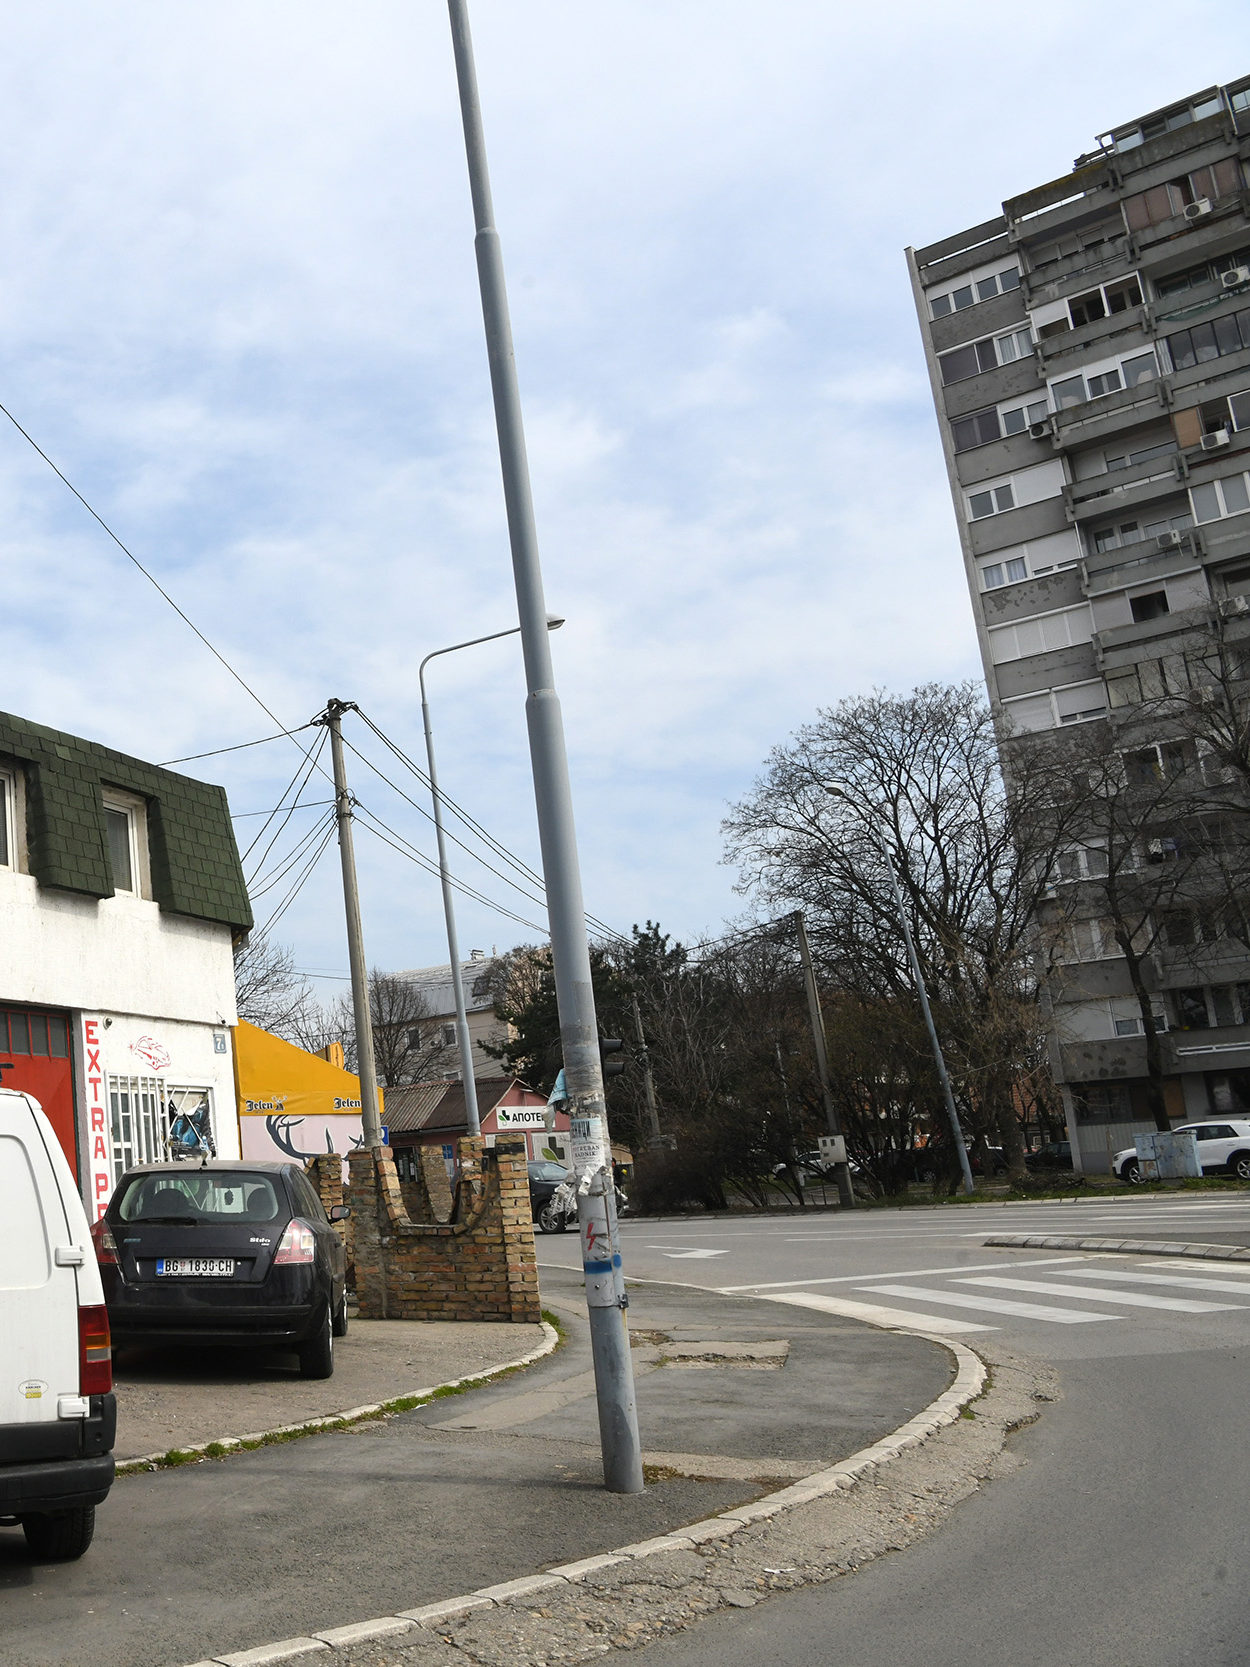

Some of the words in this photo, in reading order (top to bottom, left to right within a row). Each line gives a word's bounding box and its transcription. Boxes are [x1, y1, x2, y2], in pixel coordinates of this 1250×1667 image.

[85, 1020, 107, 1160] EXTRA
[245, 1100, 273, 1112] Jelen
[333, 1097, 361, 1110] Jelen
[512, 1112, 544, 1122] АПОТЕ
[165, 1260, 179, 1272] BG
